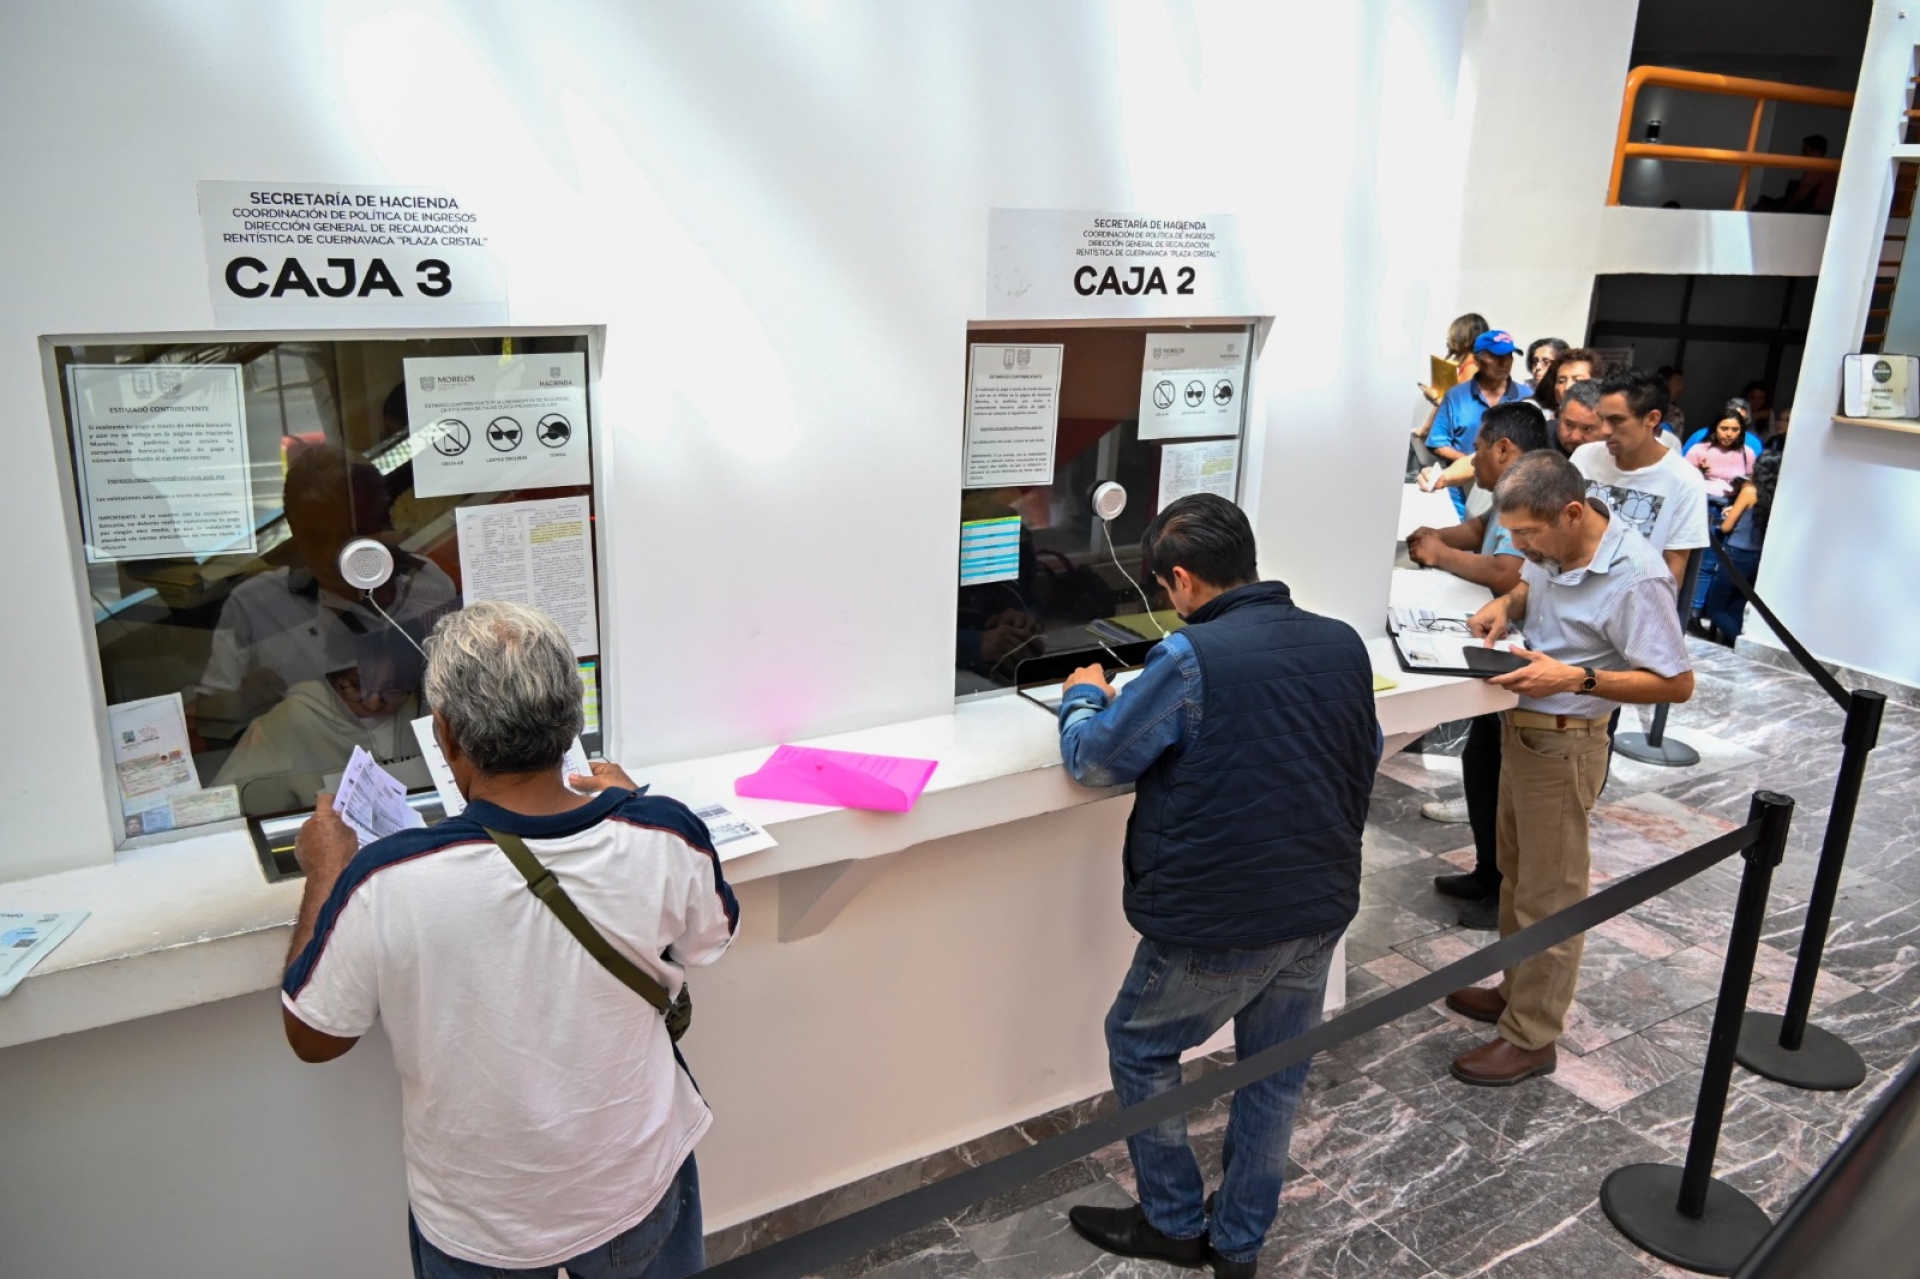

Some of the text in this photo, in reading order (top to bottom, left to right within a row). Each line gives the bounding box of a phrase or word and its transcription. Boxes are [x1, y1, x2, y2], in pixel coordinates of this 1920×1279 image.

[250, 191, 458, 209] SECRETARÍA DE HACIENDA
[232, 207, 477, 222] COORDINACIÓN DE POLÍTICA DE INGRESOS
[244, 220, 468, 234] DIRECCIÓN GENERAL DE RECAUDACIÓN
[1094, 218, 1206, 230] SECRETARÍA DE HACIENDA
[223, 232, 294, 244] RENTÍSTICA
[297, 235, 313, 244] DE
[317, 235, 395, 245] CUERNAVACA
[1083, 230, 1134, 238] COORDINACIÓN
[1146, 231, 1173, 239] POLÍTICA
[1076, 248, 1113, 256] RENTÍSTICA
[1125, 249, 1167, 257] CUERNAVACA
[225, 256, 452, 298] CAJA 3
[1074, 265, 1196, 296] CAJA 2
[438, 375, 475, 383] MORELOS
[109, 405, 210, 414] ESTIMADO CONTRIBUYENTE
